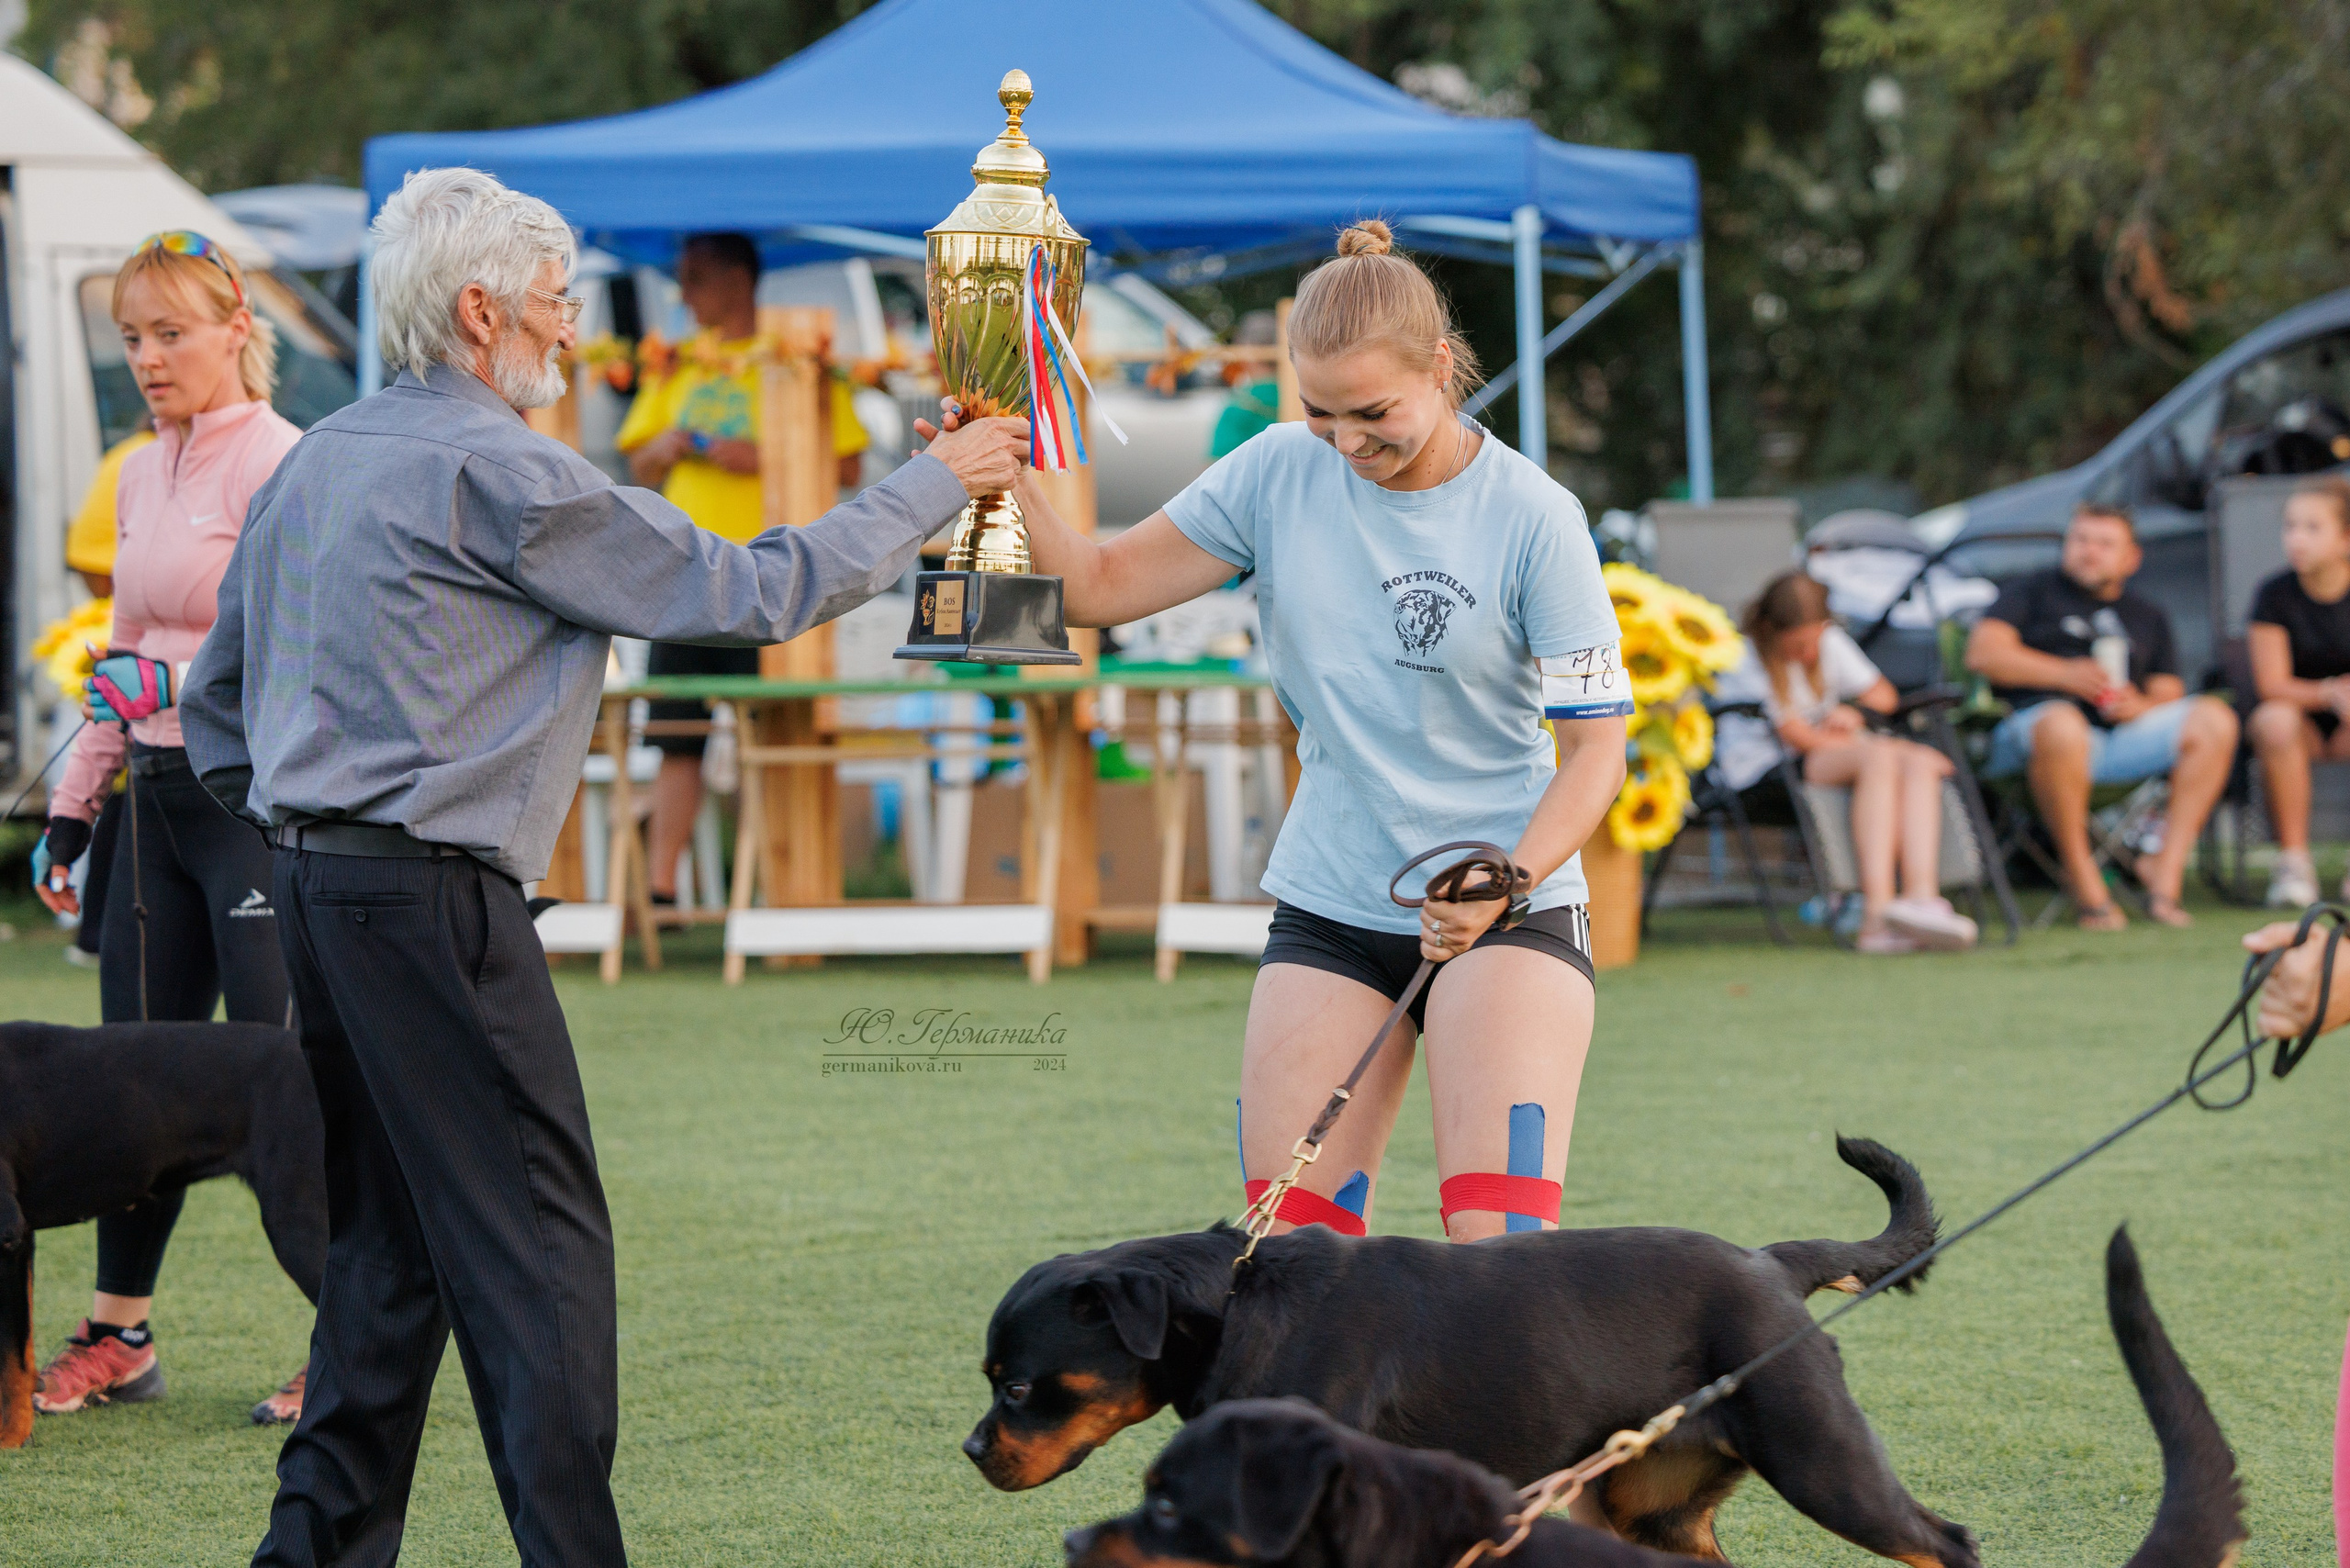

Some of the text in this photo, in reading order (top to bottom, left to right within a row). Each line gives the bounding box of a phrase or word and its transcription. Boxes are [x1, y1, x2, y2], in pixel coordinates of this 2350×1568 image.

[1381, 570, 1477, 610] ROTTWEILER
[1393, 658, 1445, 674] AUGSBURG
[1572, 647, 1615, 694] 78
